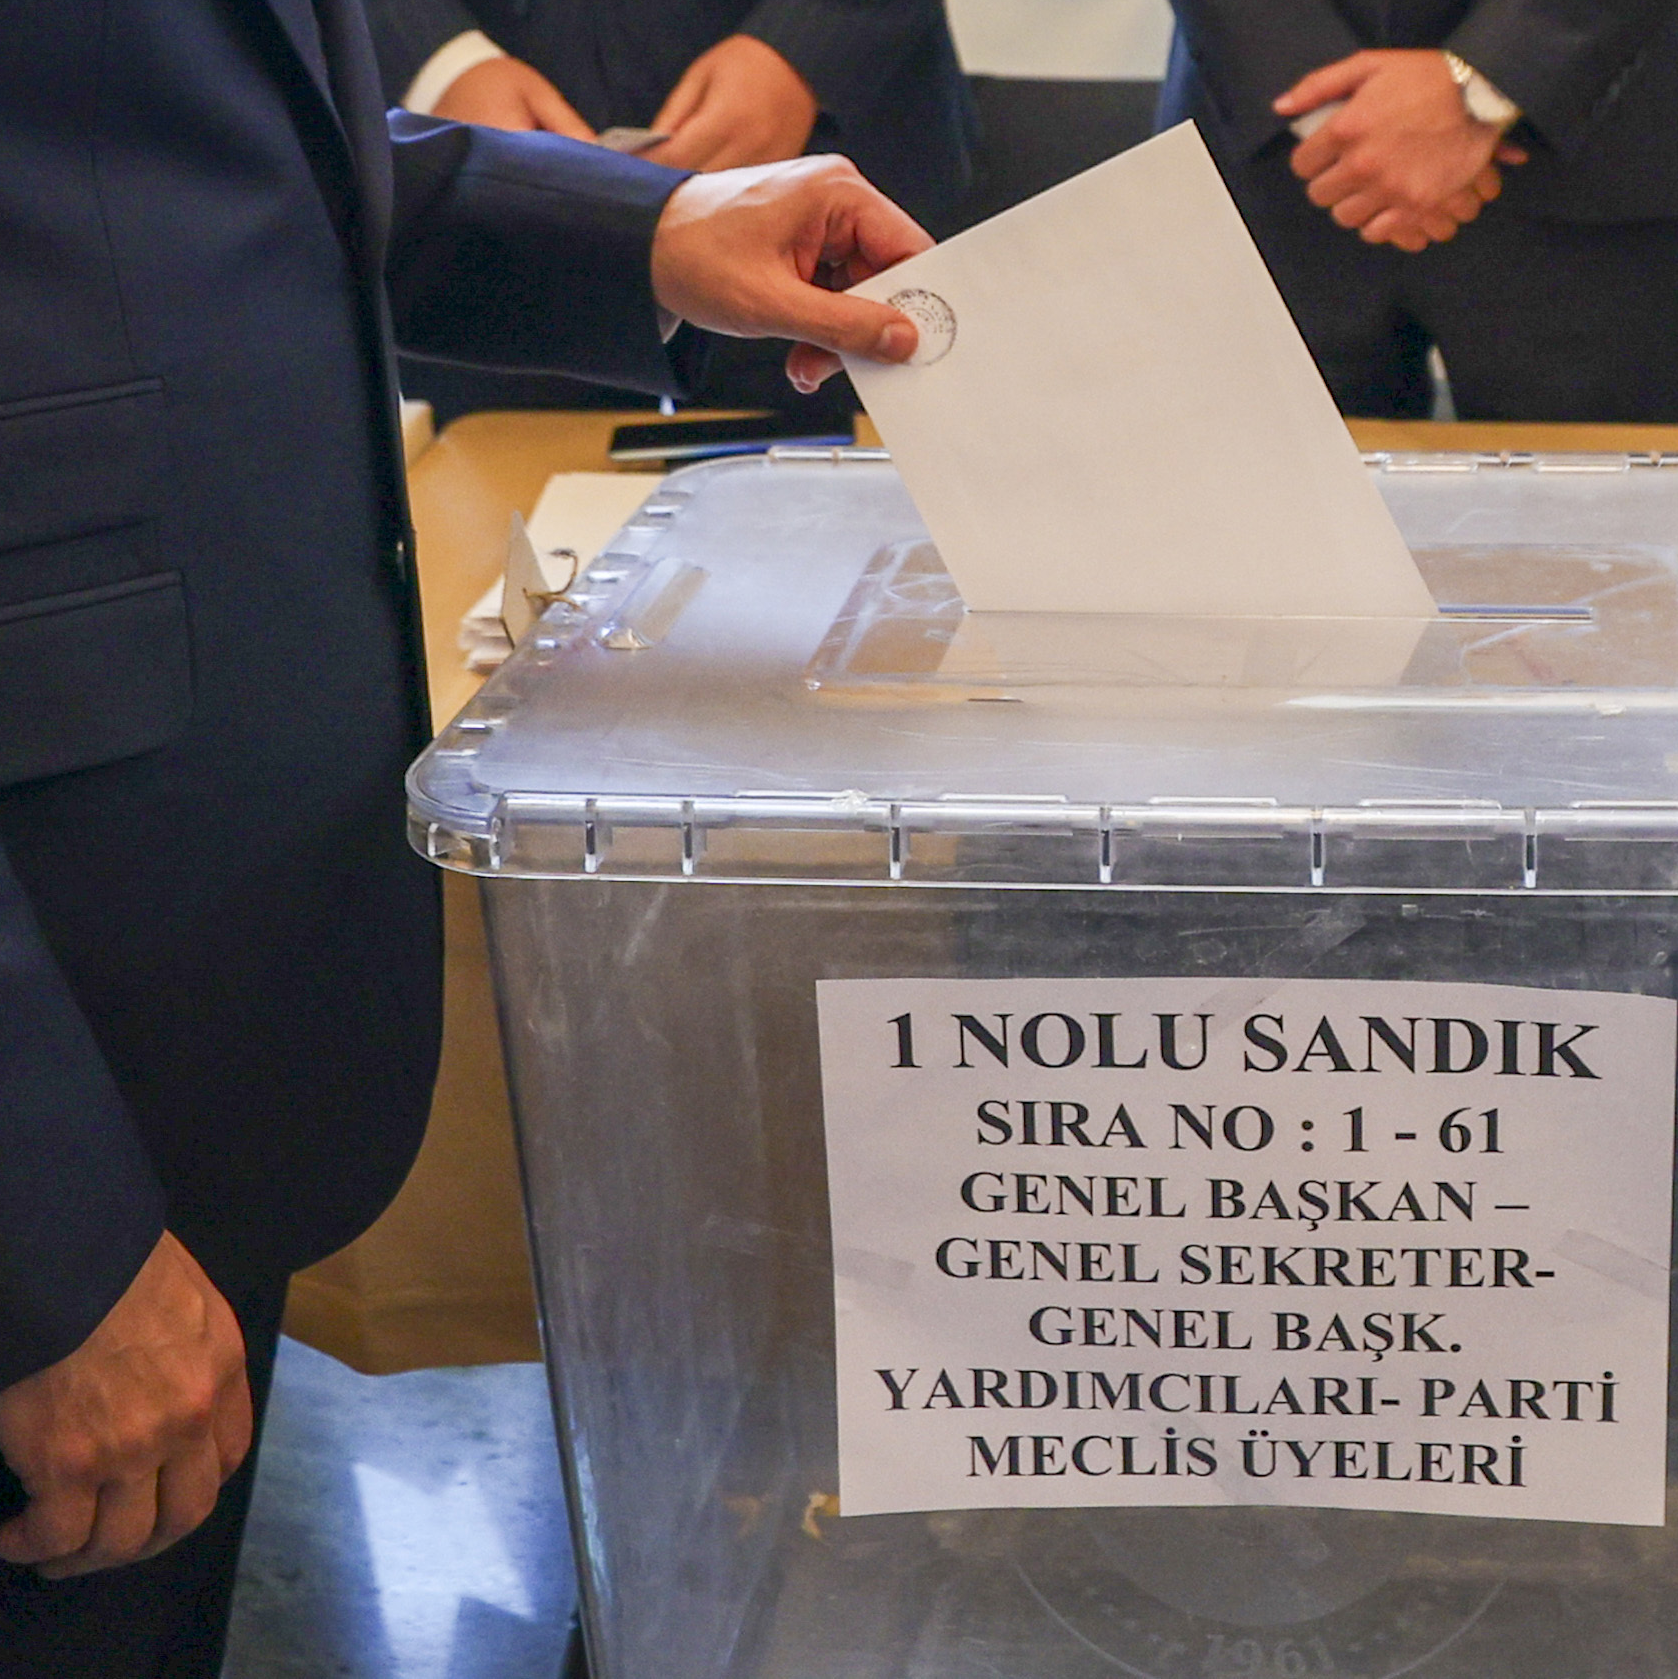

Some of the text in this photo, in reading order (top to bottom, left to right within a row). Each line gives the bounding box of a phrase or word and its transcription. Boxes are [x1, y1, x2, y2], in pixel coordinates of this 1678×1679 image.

[887, 1012, 1603, 1081] 1 NOLU SANDIK
[977, 1100, 1148, 1149] SIRA
[1168, 1103, 1276, 1152] NO
[1343, 1106, 1368, 1153] 1
[1438, 1107, 1505, 1154] 61
[960, 1171, 1187, 1218] GENEL
[1206, 1178, 1477, 1232] BAŞKAN
[935, 1237, 1556, 1289] GENEL SEKRETER-
[1028, 1305, 1462, 1363] GENEL BAŞK.
[874, 1368, 1619, 1423] YARDIMCILARI- PARTİ
[967, 1426, 1527, 1488] MECLİS ÜYELERİ
